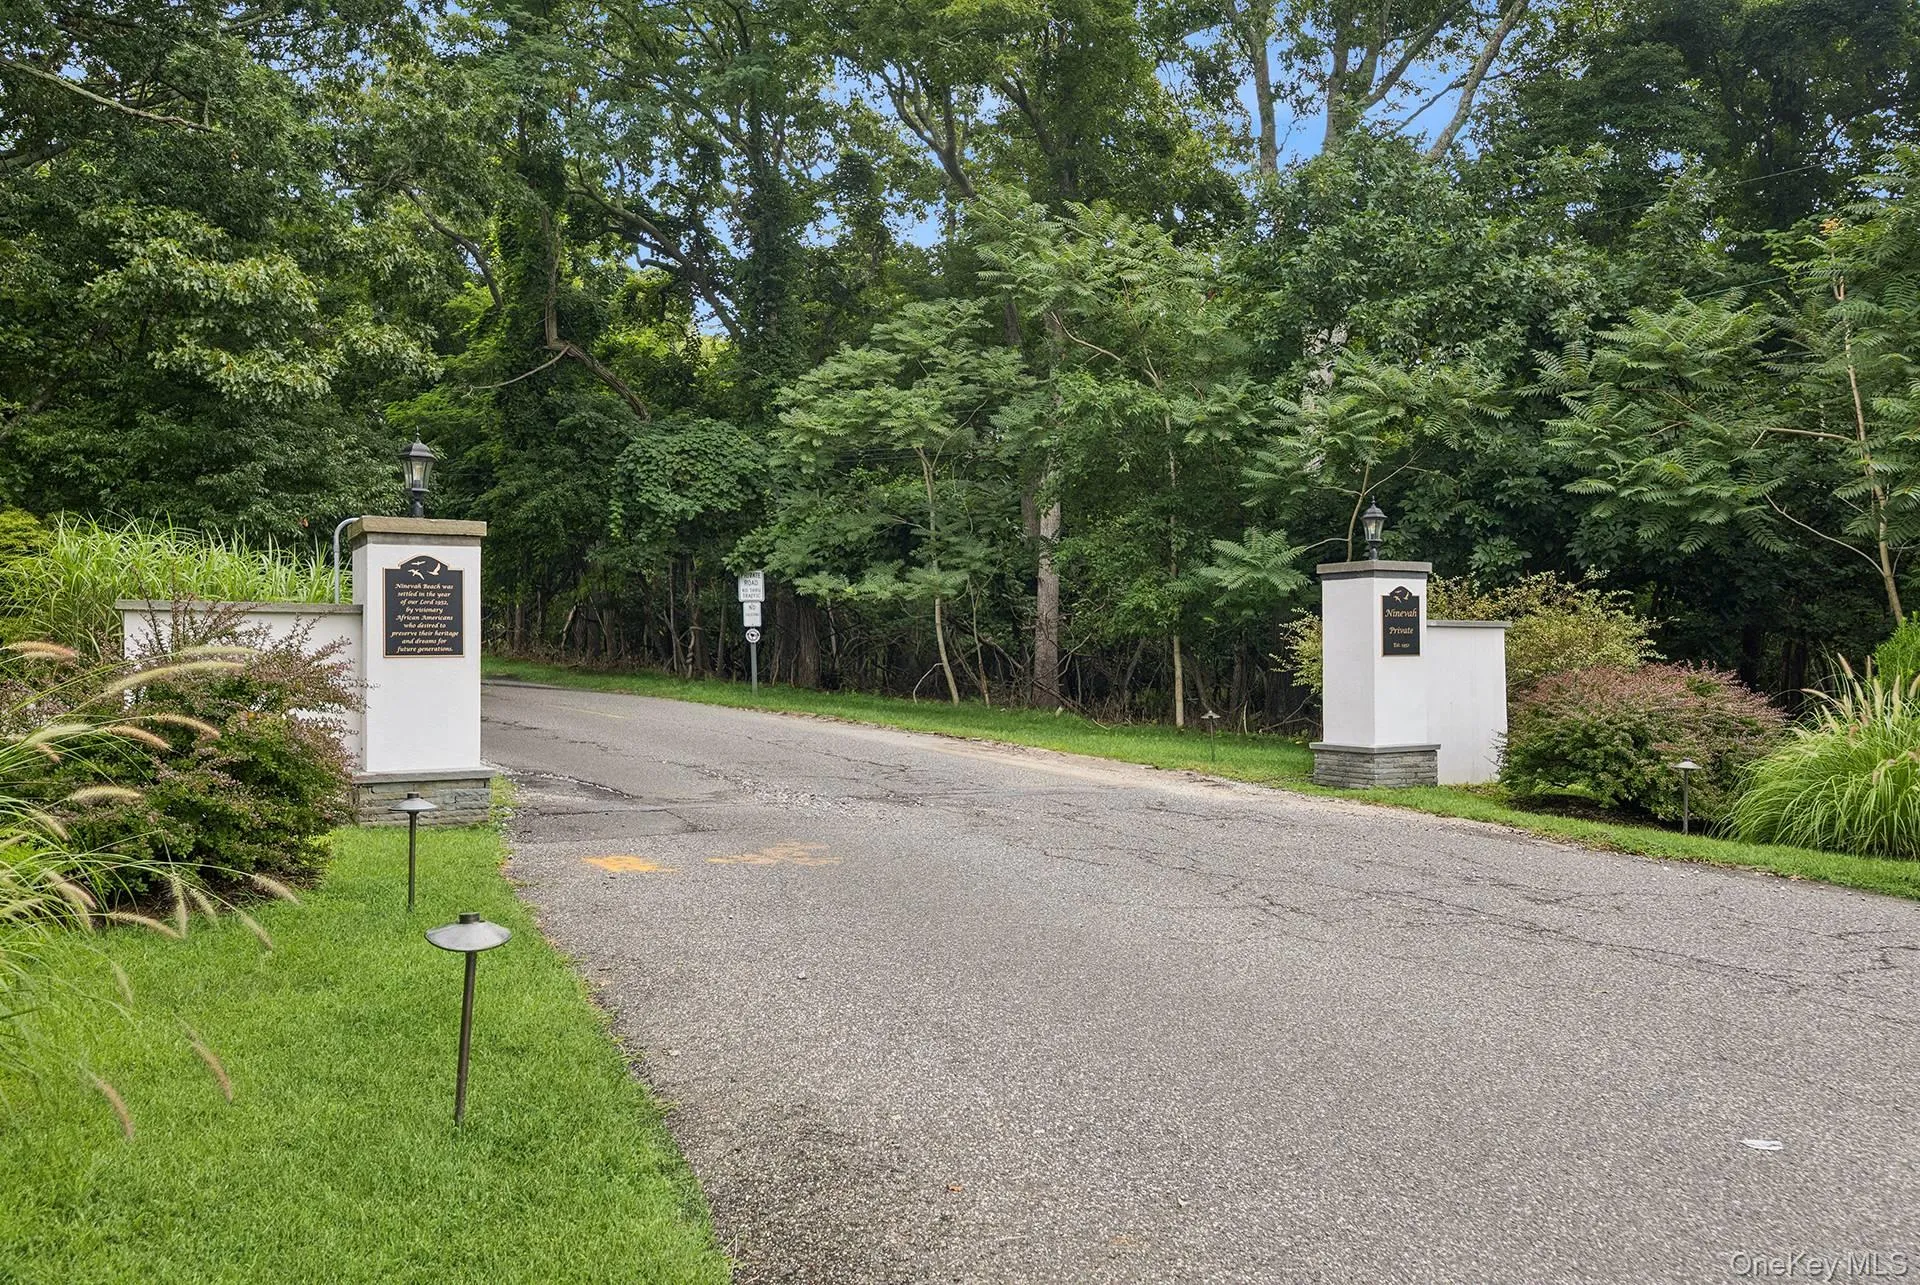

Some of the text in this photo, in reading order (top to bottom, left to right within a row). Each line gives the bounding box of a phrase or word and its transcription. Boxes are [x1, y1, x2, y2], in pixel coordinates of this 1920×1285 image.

[1385, 608, 1417, 617] Ninevah
[396, 614, 419, 622] African
[434, 630, 459, 638] heritage
[1389, 626, 1414, 634] Private
